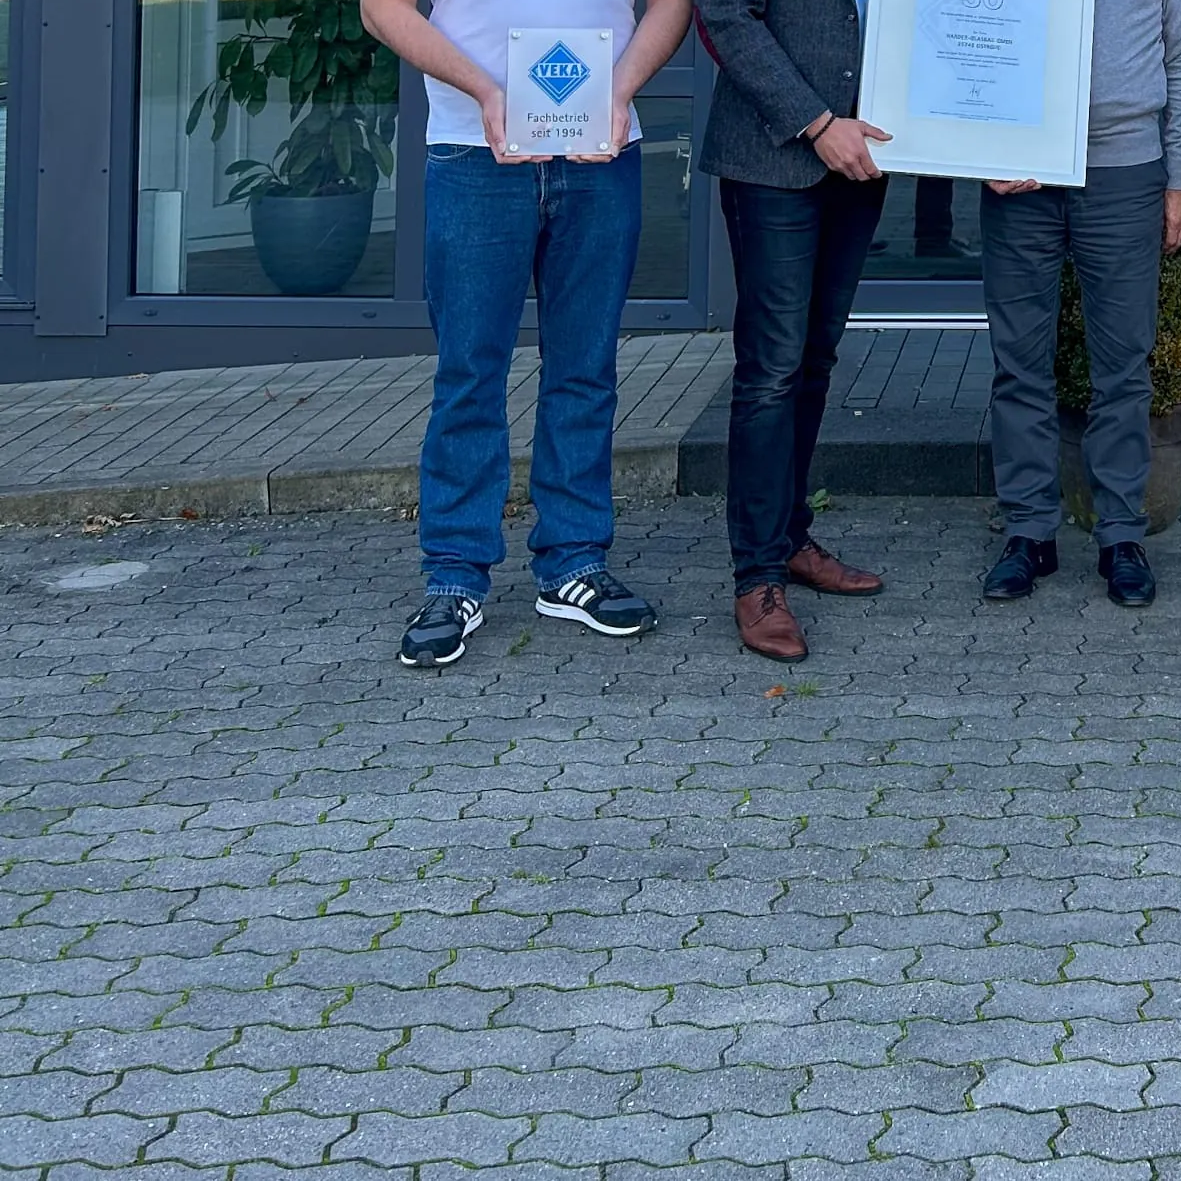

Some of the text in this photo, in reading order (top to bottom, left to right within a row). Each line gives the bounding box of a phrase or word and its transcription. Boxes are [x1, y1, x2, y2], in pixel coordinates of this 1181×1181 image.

[539, 64, 580, 77] VEKA
[527, 112, 589, 123] Fachbetrieb
[531, 128, 583, 138] seit 1994
